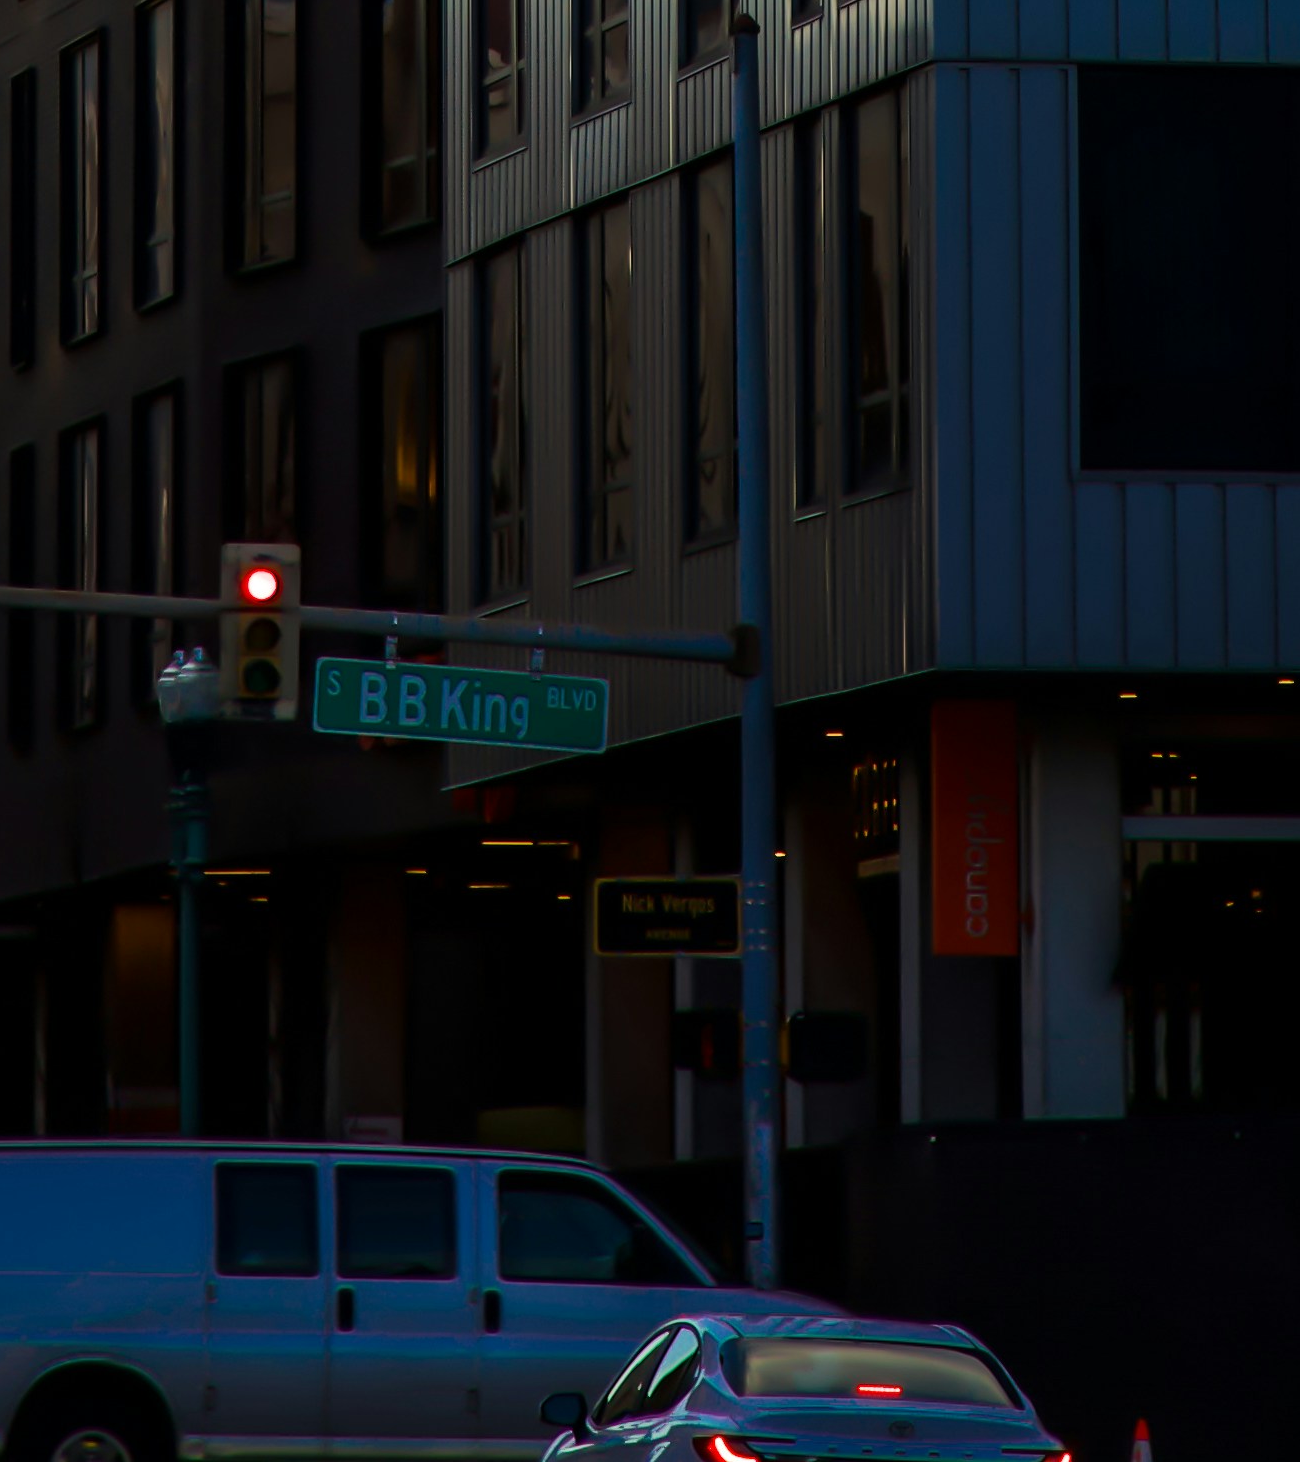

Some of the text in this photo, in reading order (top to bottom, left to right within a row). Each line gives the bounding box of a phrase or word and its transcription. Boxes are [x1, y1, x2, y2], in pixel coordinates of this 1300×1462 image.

[326, 670, 342, 696] S
[440, 677, 530, 740] King
[546, 686, 597, 712] BLVD
[622, 893, 656, 914] Nick
